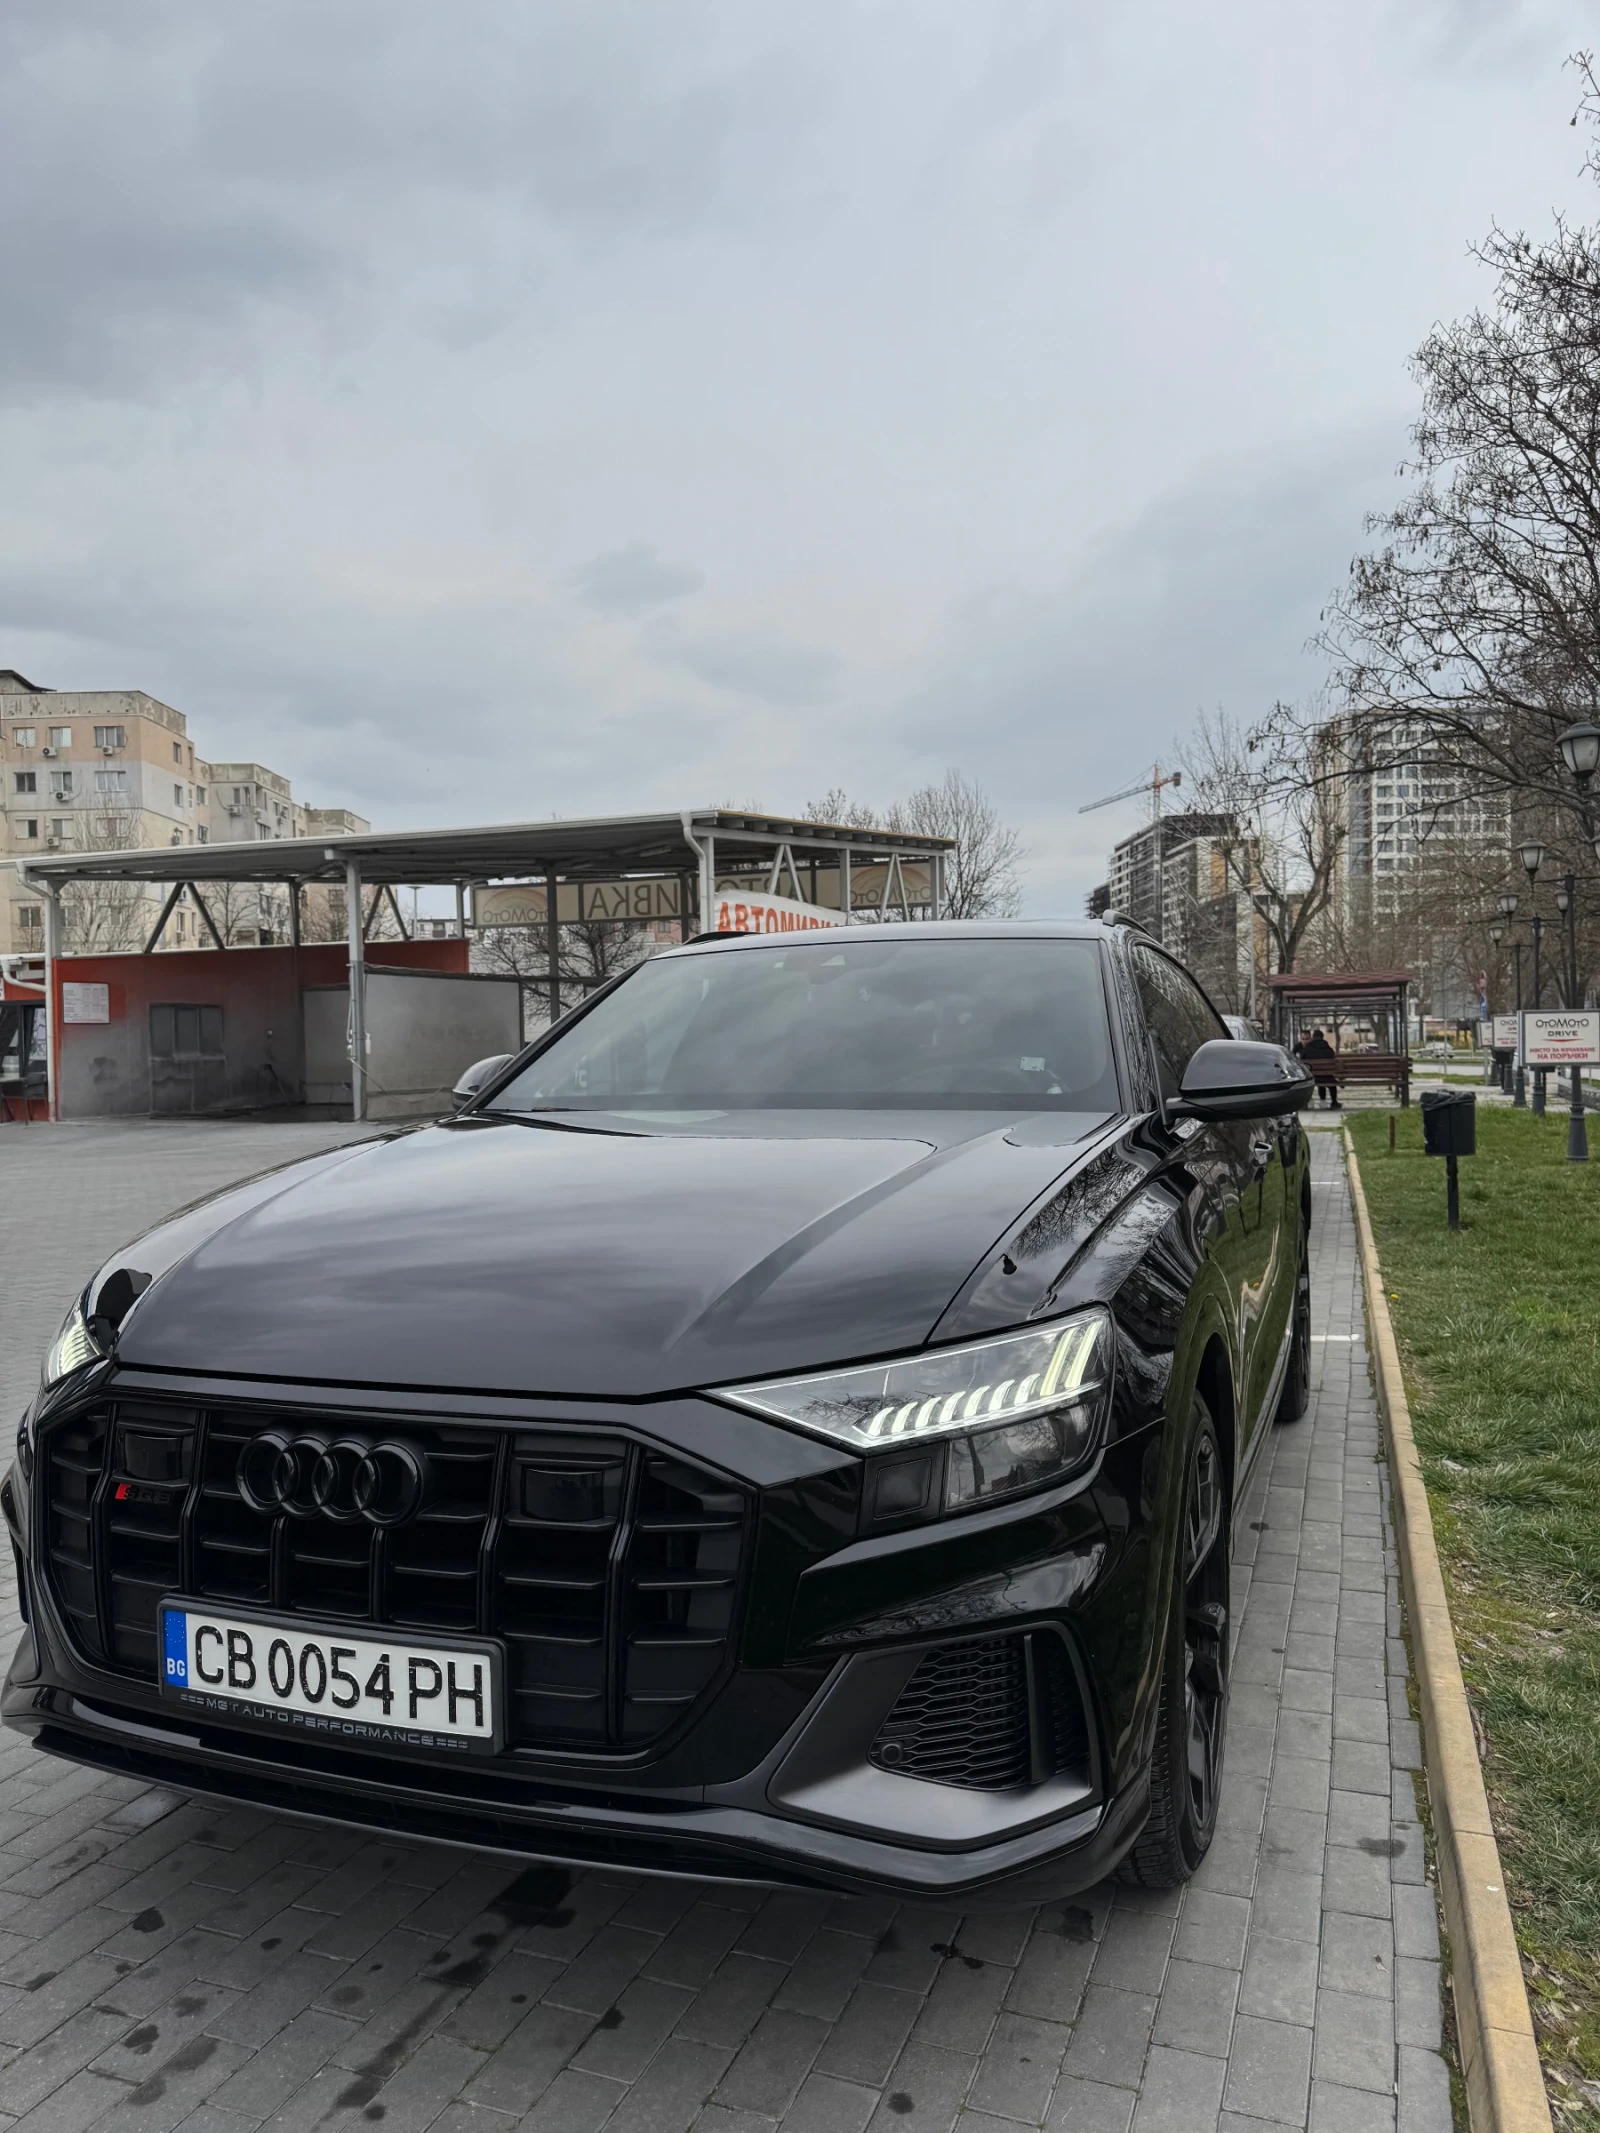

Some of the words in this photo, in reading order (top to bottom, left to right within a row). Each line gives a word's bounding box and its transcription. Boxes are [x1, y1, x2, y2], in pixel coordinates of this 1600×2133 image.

[167, 1657, 186, 1677] BG
[194, 1624, 257, 1690] CB
[267, 1637, 395, 1716] 0054
[408, 1655, 485, 1728] PH
[242, 1705, 289, 1723] AUTO
[292, 1713, 434, 1747] PERFORMANCE
